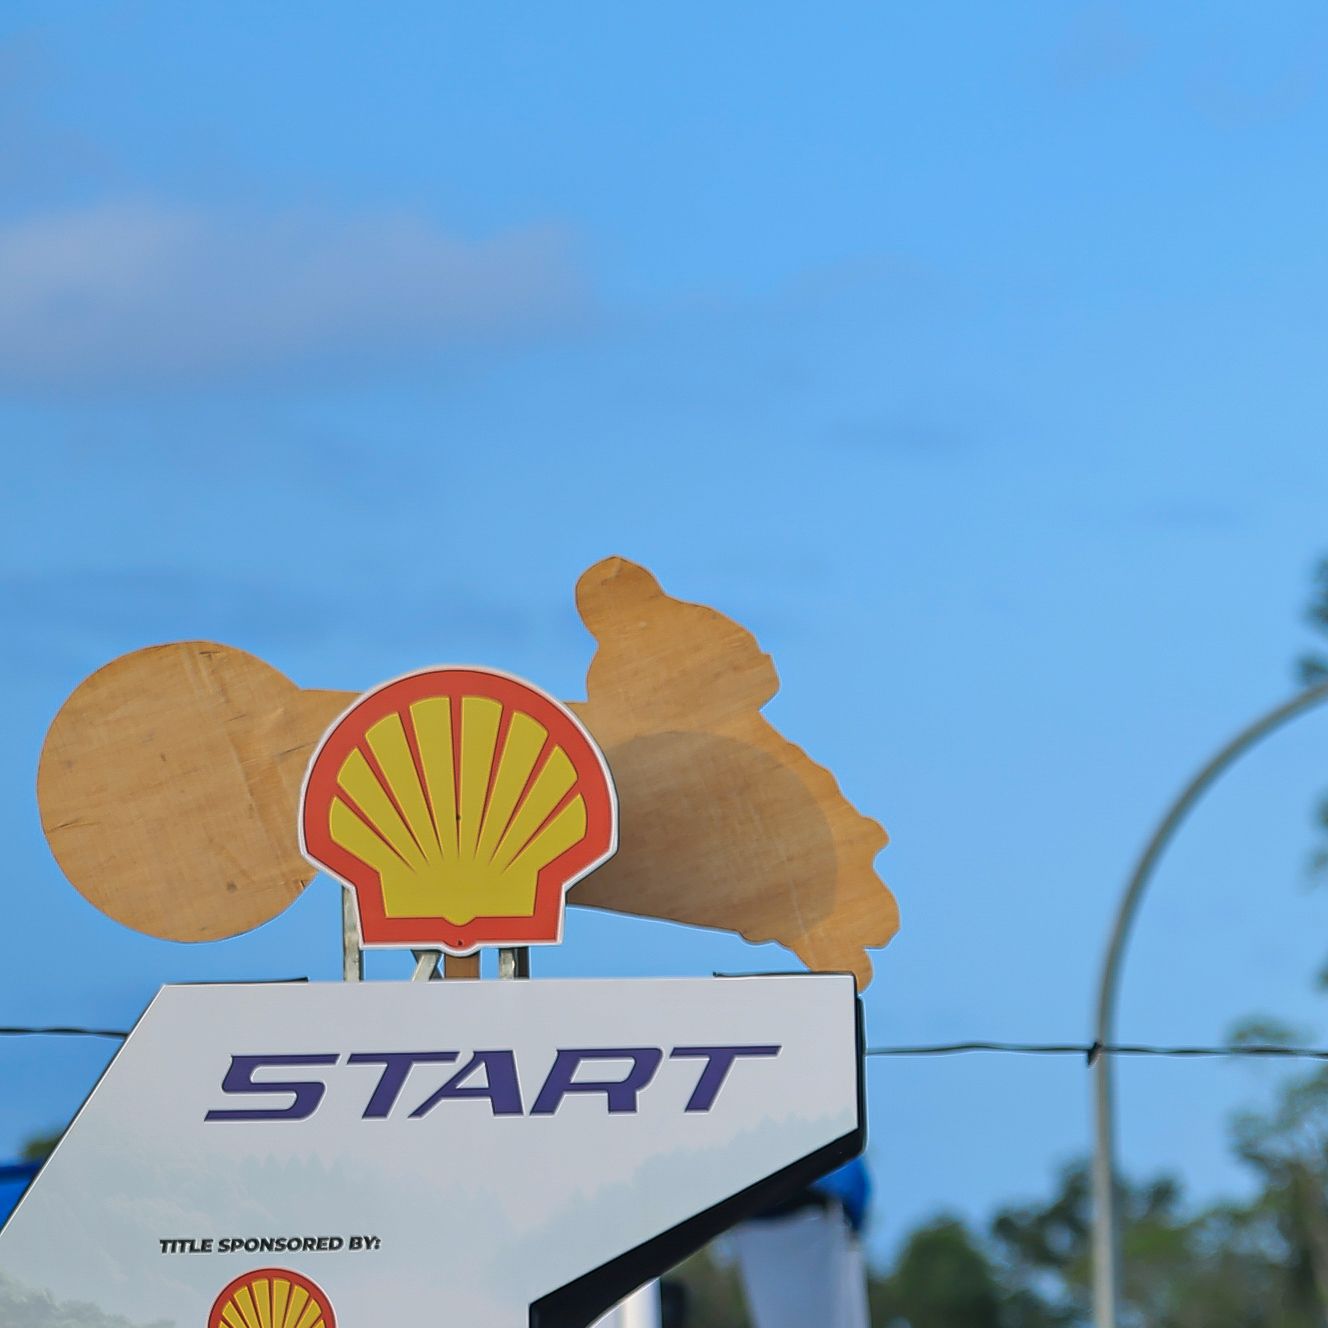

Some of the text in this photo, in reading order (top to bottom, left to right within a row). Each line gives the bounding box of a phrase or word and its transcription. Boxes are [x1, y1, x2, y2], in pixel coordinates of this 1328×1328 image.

[204, 1045, 782, 1122] START
[160, 1235, 382, 1254] TITLE SPONSORED BY:
